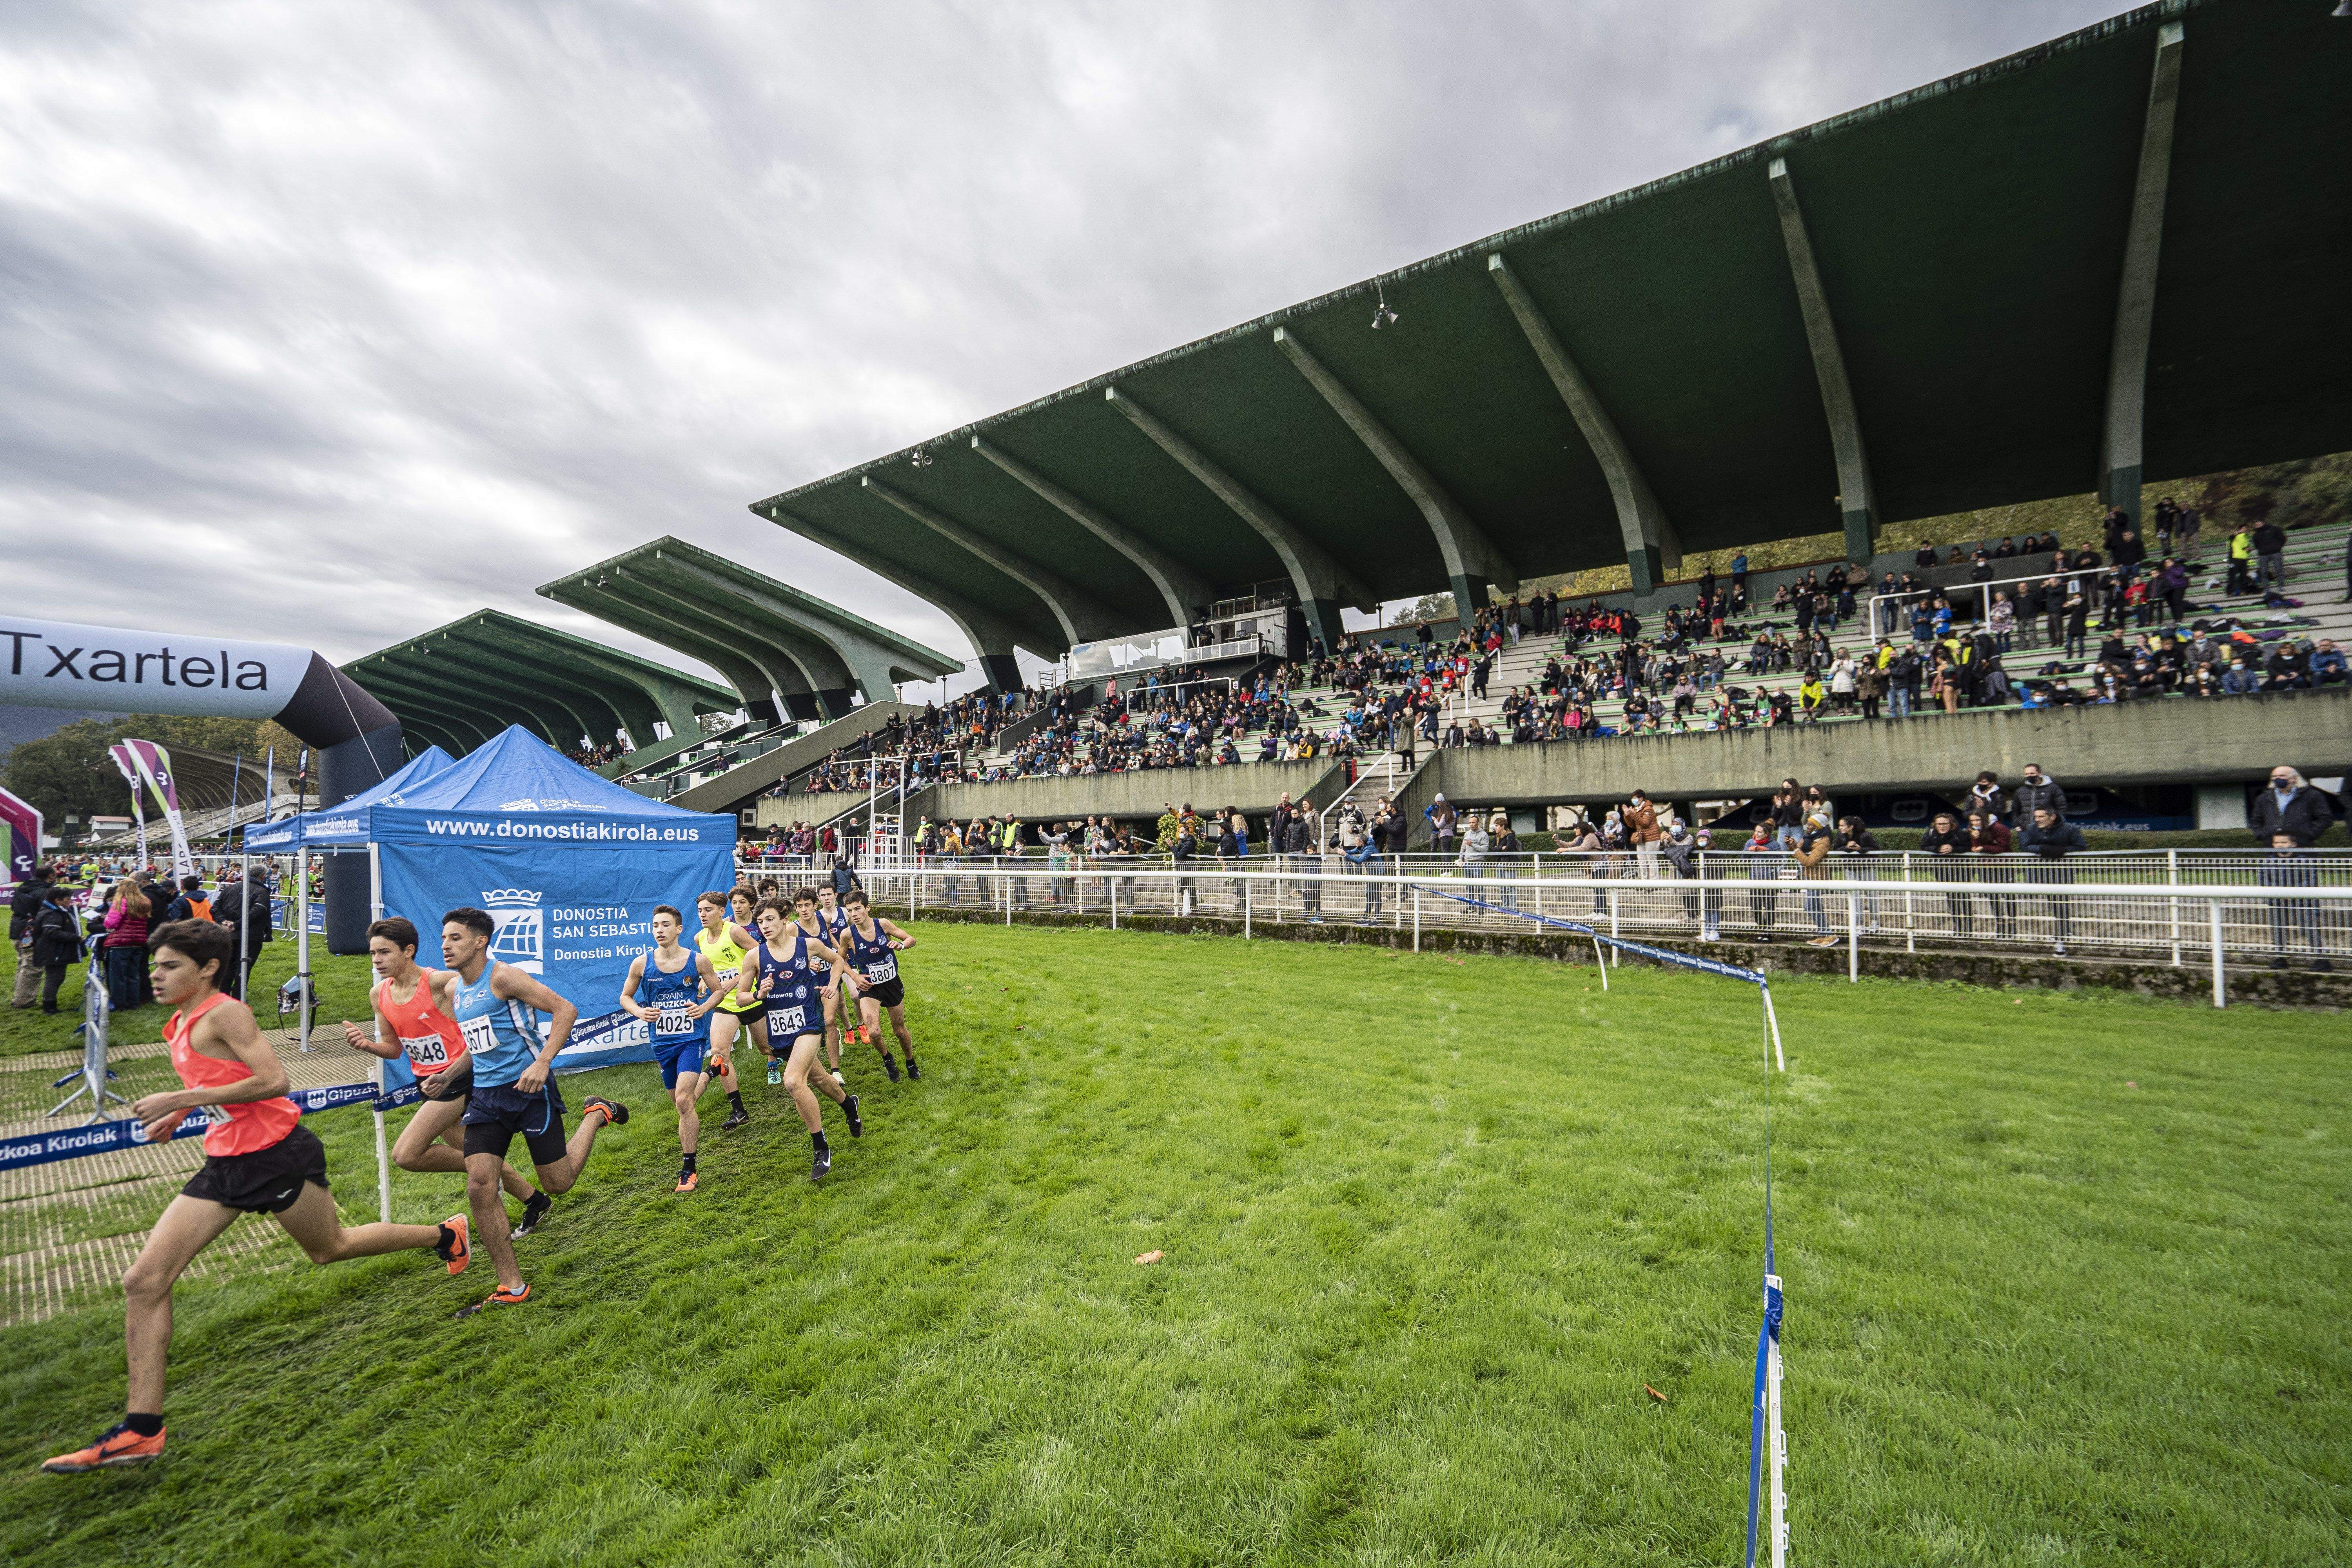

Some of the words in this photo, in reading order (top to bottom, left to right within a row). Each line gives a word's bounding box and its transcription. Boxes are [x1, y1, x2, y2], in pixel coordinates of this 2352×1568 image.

[0, 630, 268, 691] Txartela
[426, 820, 699, 841] www.donostiakirola.eus
[553, 907, 628, 921] DONOSTIA
[553, 926, 584, 938] SAN
[589, 922, 653, 937] SEBASTI
[554, 947, 612, 960] Donostia
[616, 944, 653, 956] Kirola
[870, 965, 894, 983] 3807
[652, 998, 692, 1008] GIPUZKOA
[657, 992, 683, 1000] ORAIN
[577, 1024, 596, 1037] Gipuzkoa
[595, 1017, 610, 1031] Kirolak
[657, 1014, 692, 1033] 4025
[771, 1013, 804, 1033] 3643
[405, 1041, 445, 1062] 3648
[47, 1129, 118, 1153] Kirolak
